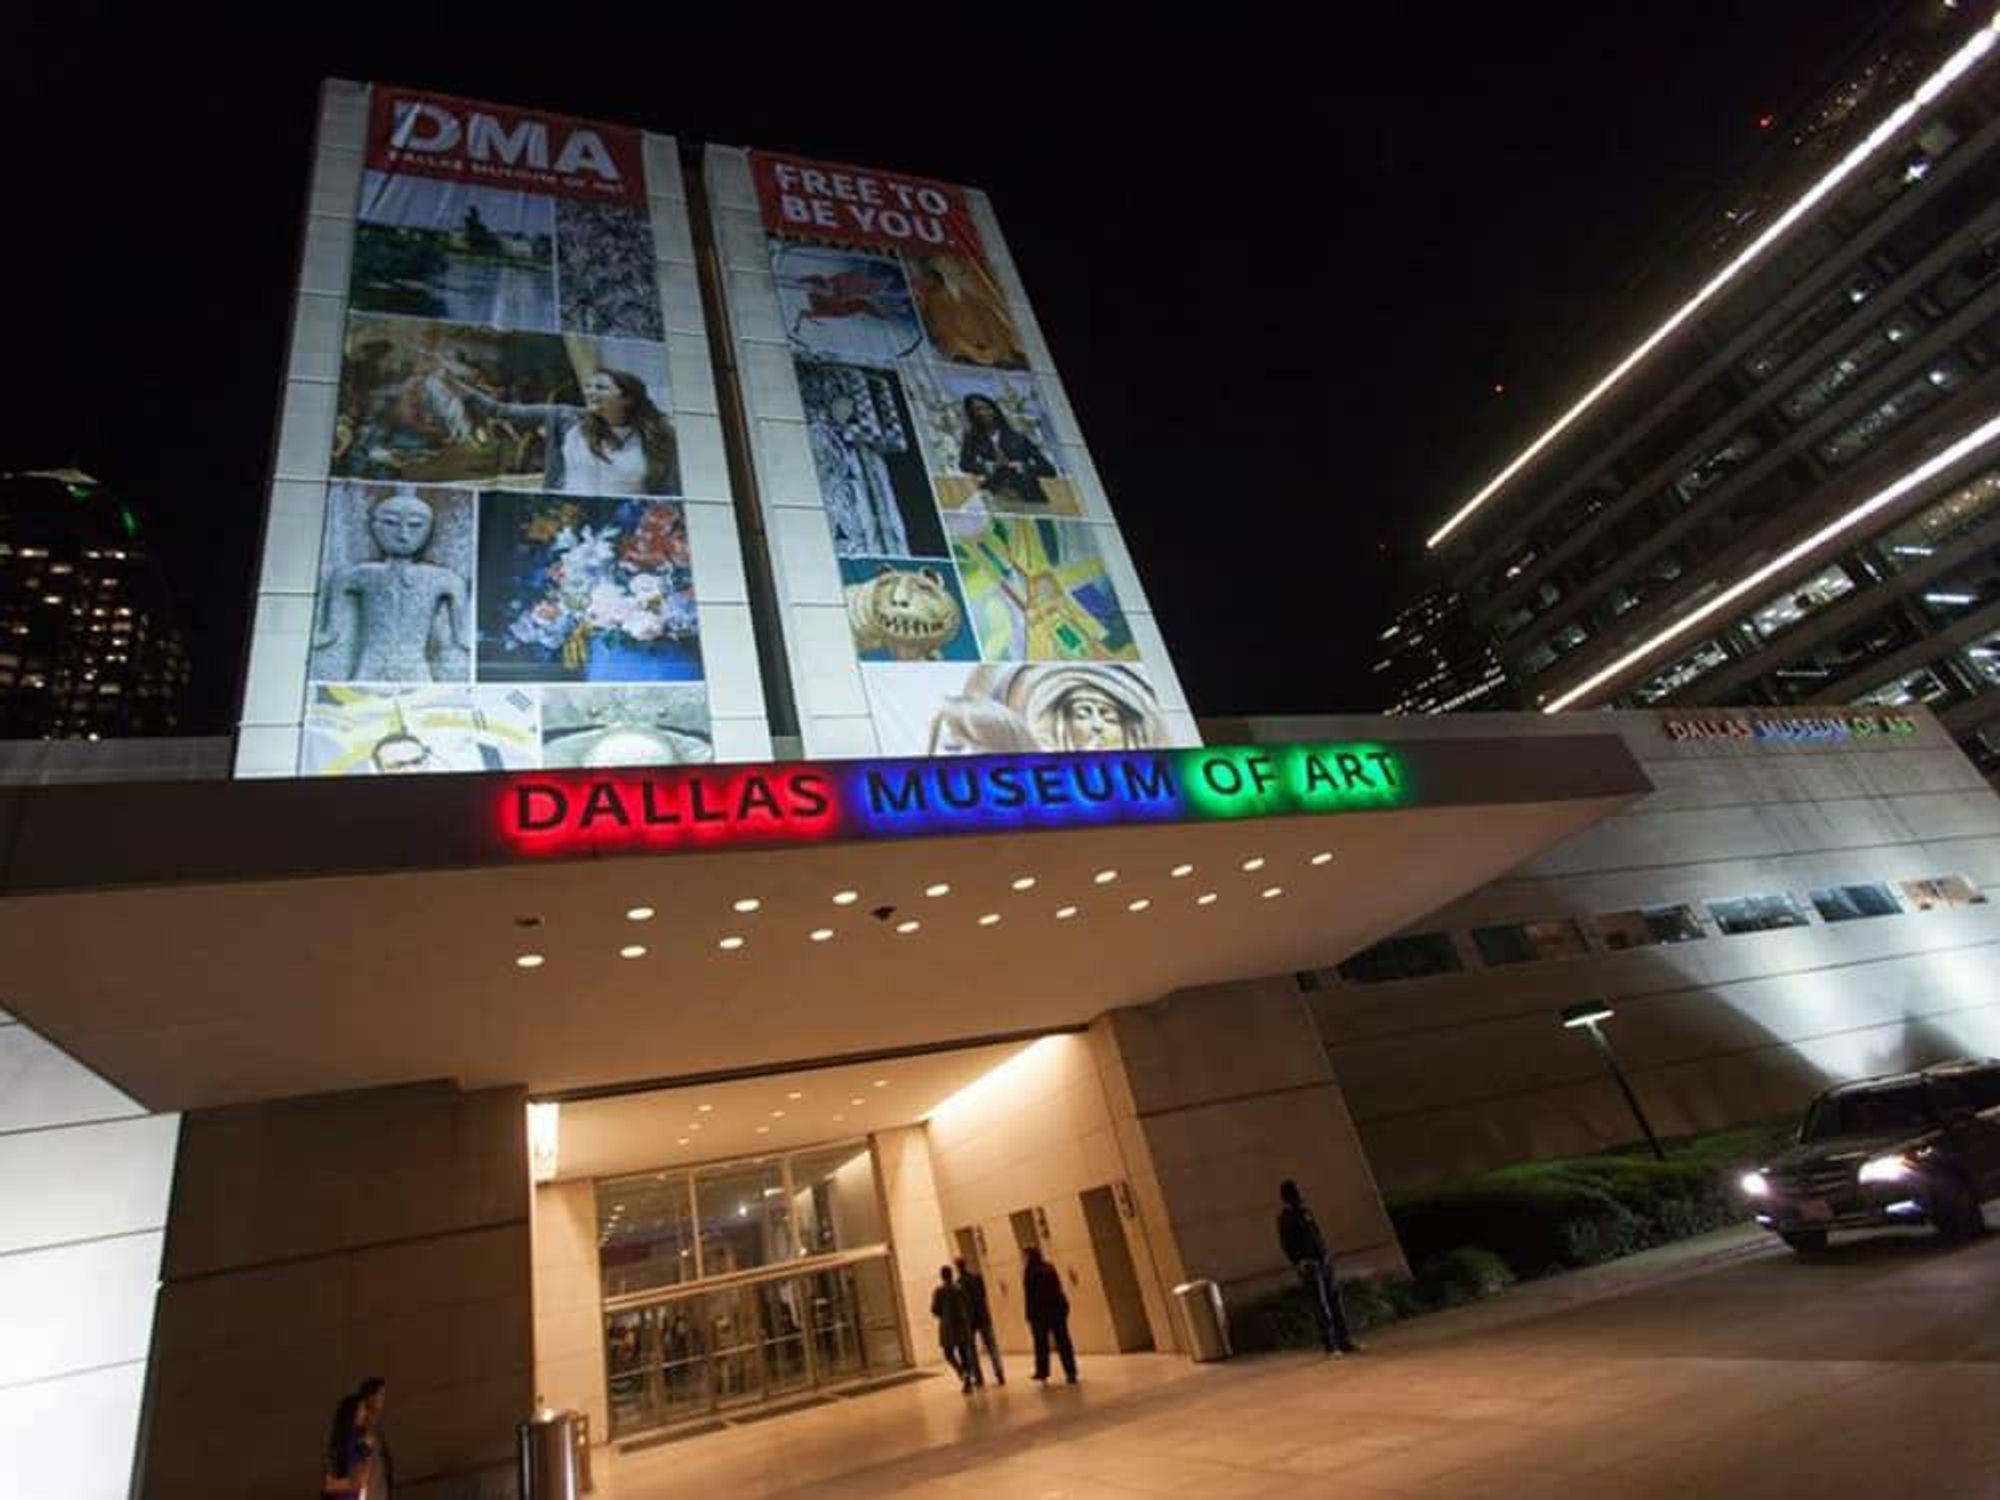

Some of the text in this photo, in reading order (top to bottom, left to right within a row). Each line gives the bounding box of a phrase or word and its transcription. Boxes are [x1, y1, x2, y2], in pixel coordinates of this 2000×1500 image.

[390, 100, 620, 182] DMA
[775, 163, 949, 216] FREE TO
[781, 194, 955, 245] BE YOU.
[1666, 719, 1753, 741] DALLAS
[517, 751, 1398, 832] DALLAS MUSEUM OF ART
